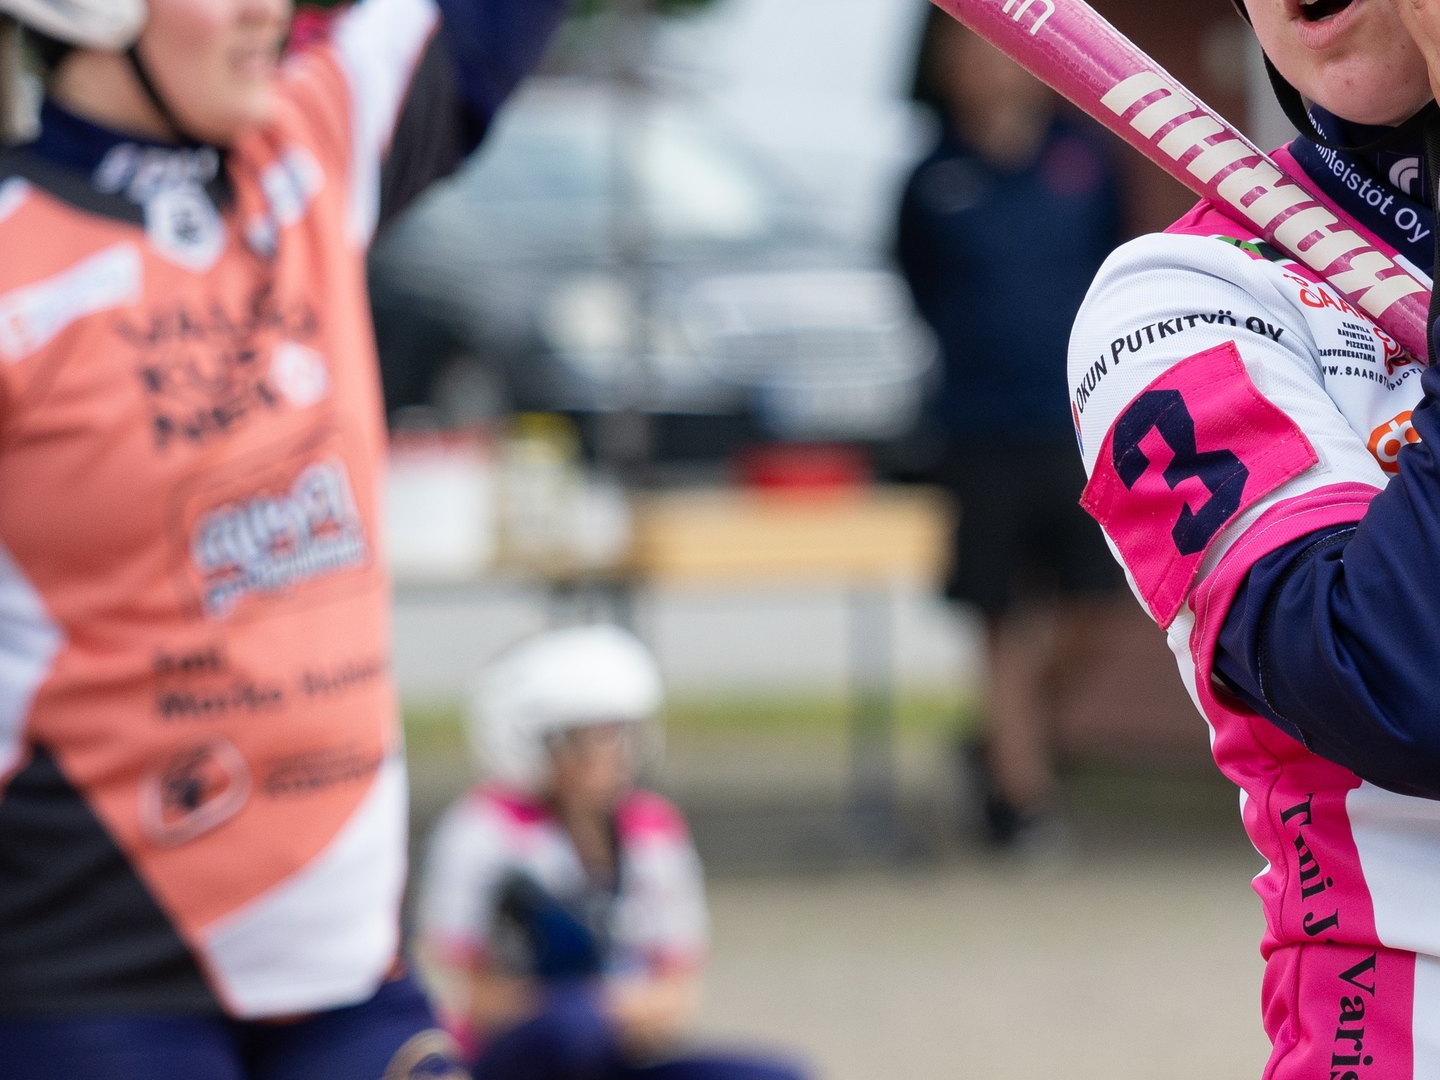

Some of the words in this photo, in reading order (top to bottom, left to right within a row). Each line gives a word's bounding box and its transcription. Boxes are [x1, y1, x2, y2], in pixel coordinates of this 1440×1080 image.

[1100, 71, 1427, 318] KARHU
[1315, 143, 1394, 216] iinteistöt
[1394, 207, 1431, 244] Oy
[1337, 328, 1374, 343] RAVINTOLA
[1345, 339, 1376, 353] PIZZERIA
[1112, 389, 1250, 556] 3
